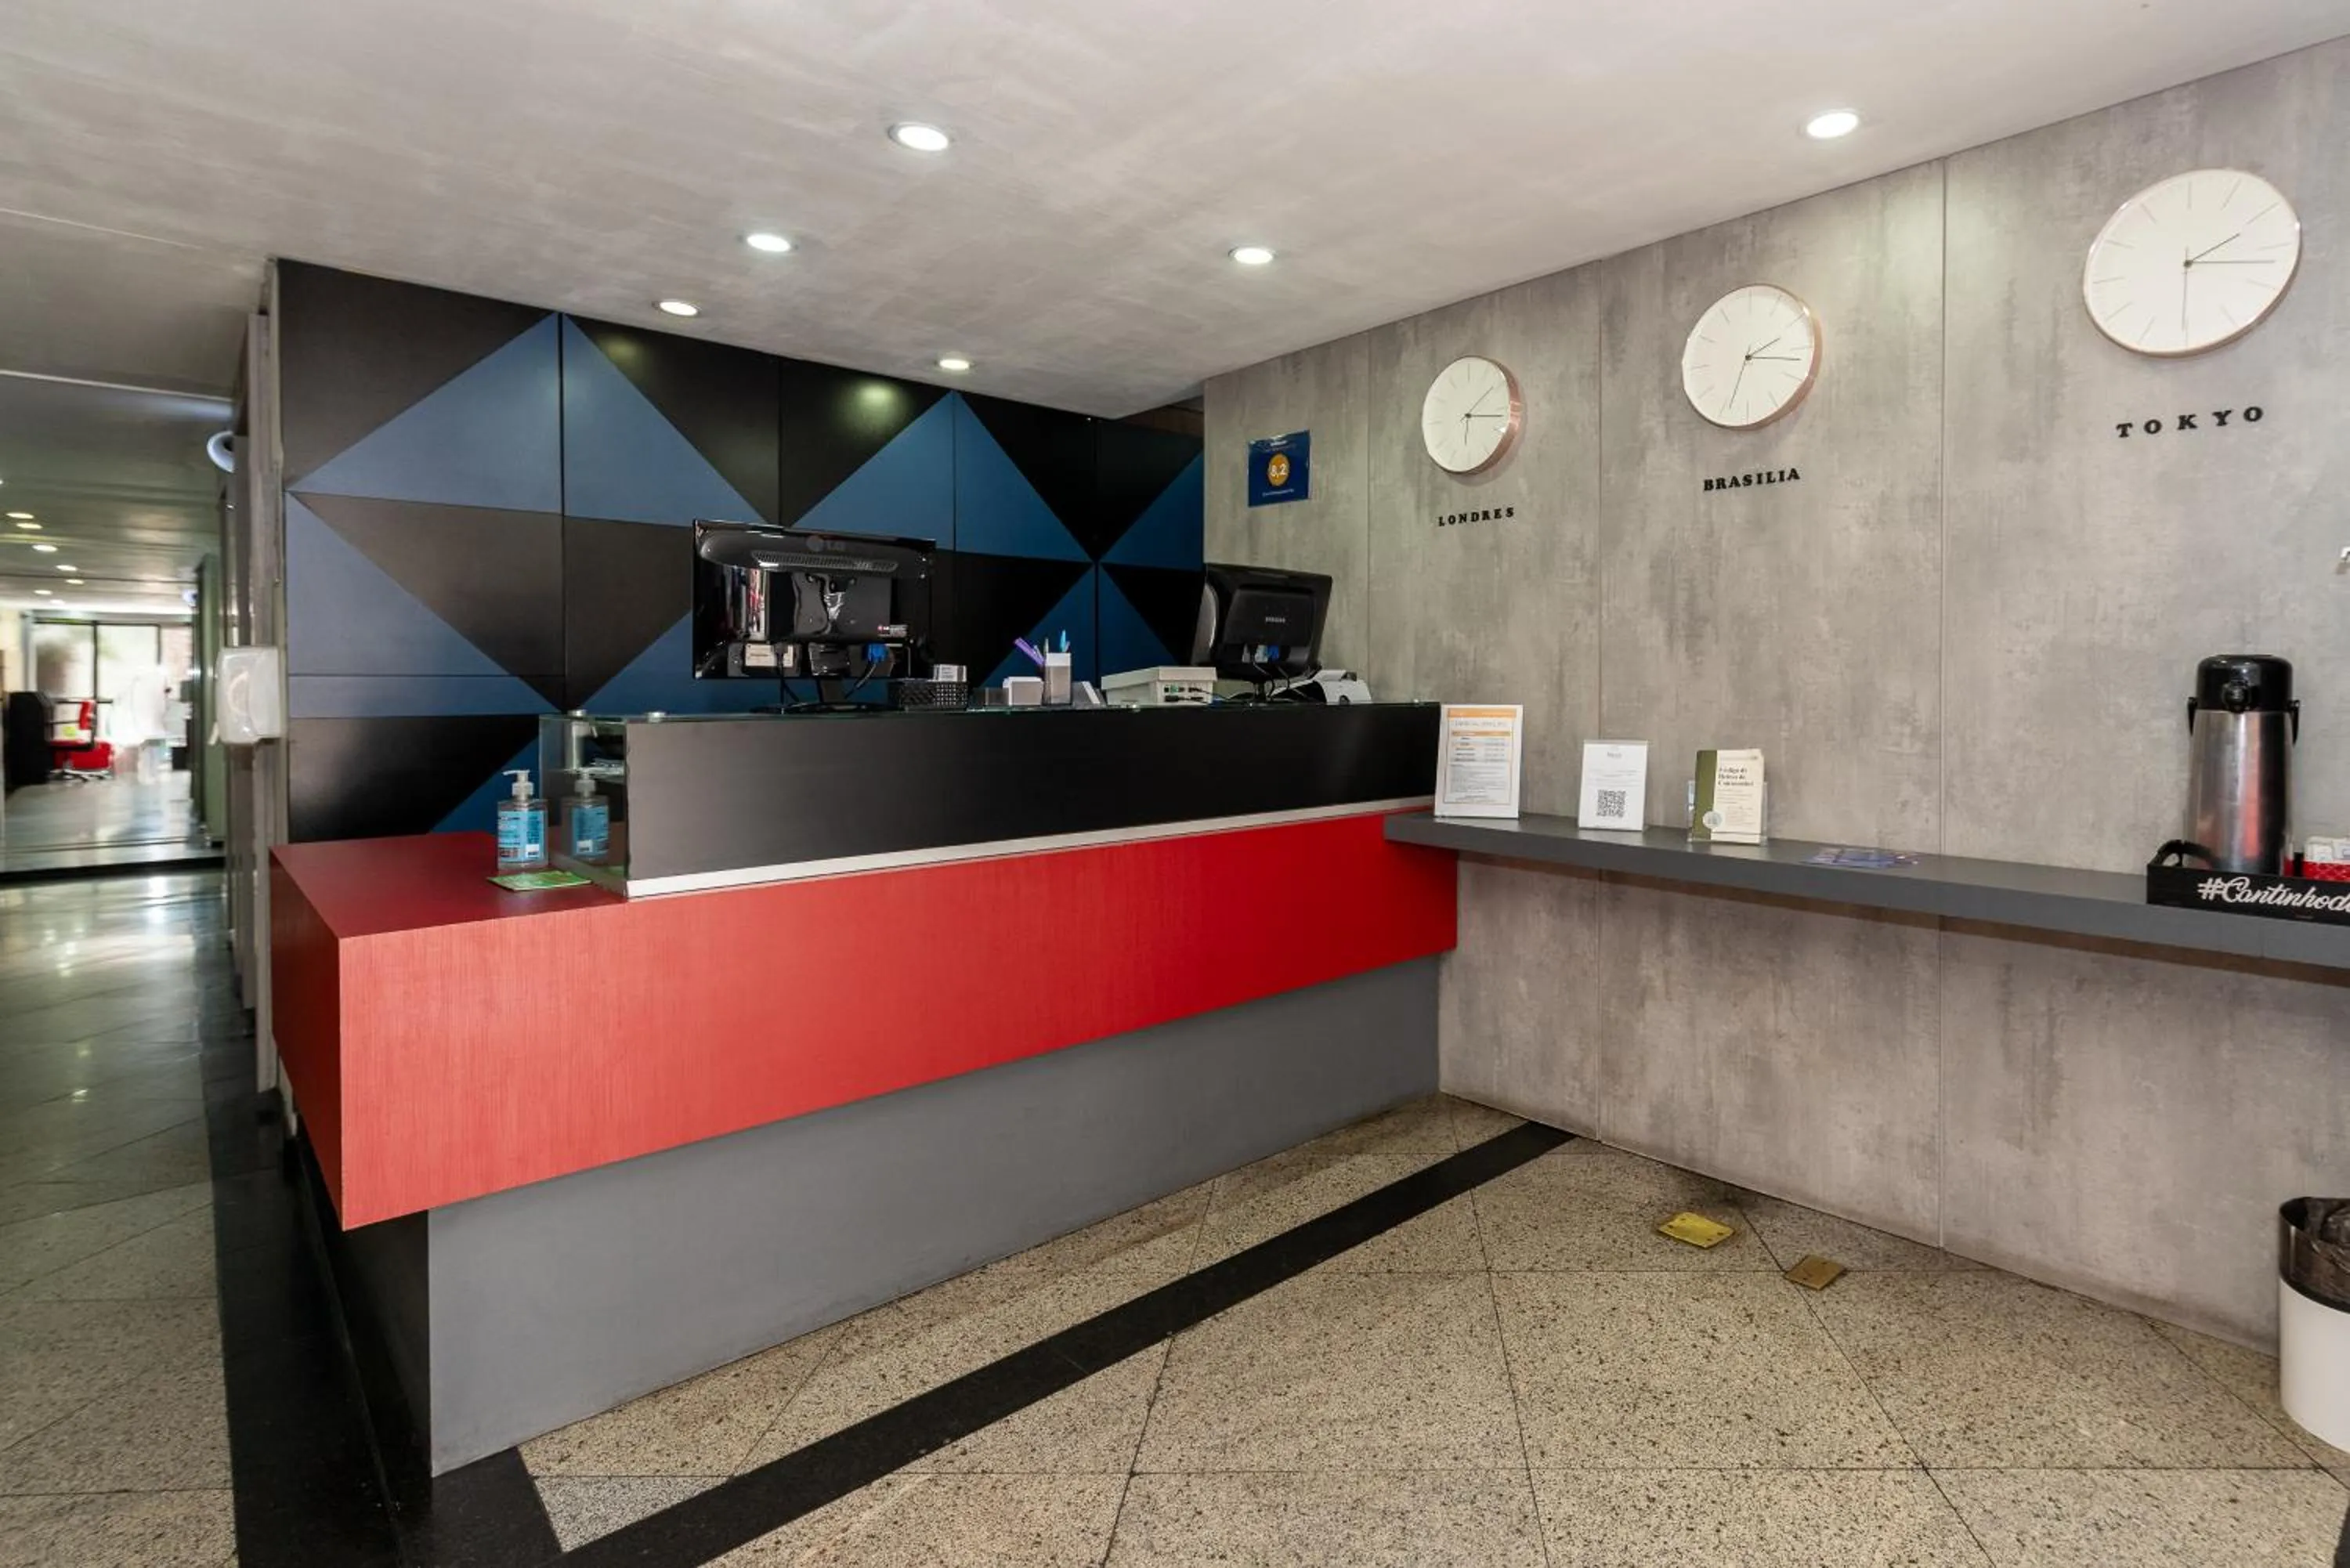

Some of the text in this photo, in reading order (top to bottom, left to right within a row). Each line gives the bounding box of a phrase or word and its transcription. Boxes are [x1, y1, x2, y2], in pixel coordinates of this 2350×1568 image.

[2116, 406, 2264, 438] TOKYO
[1703, 468, 1801, 492] BRASILIA
[1437, 507, 1516, 527] LONDRES
